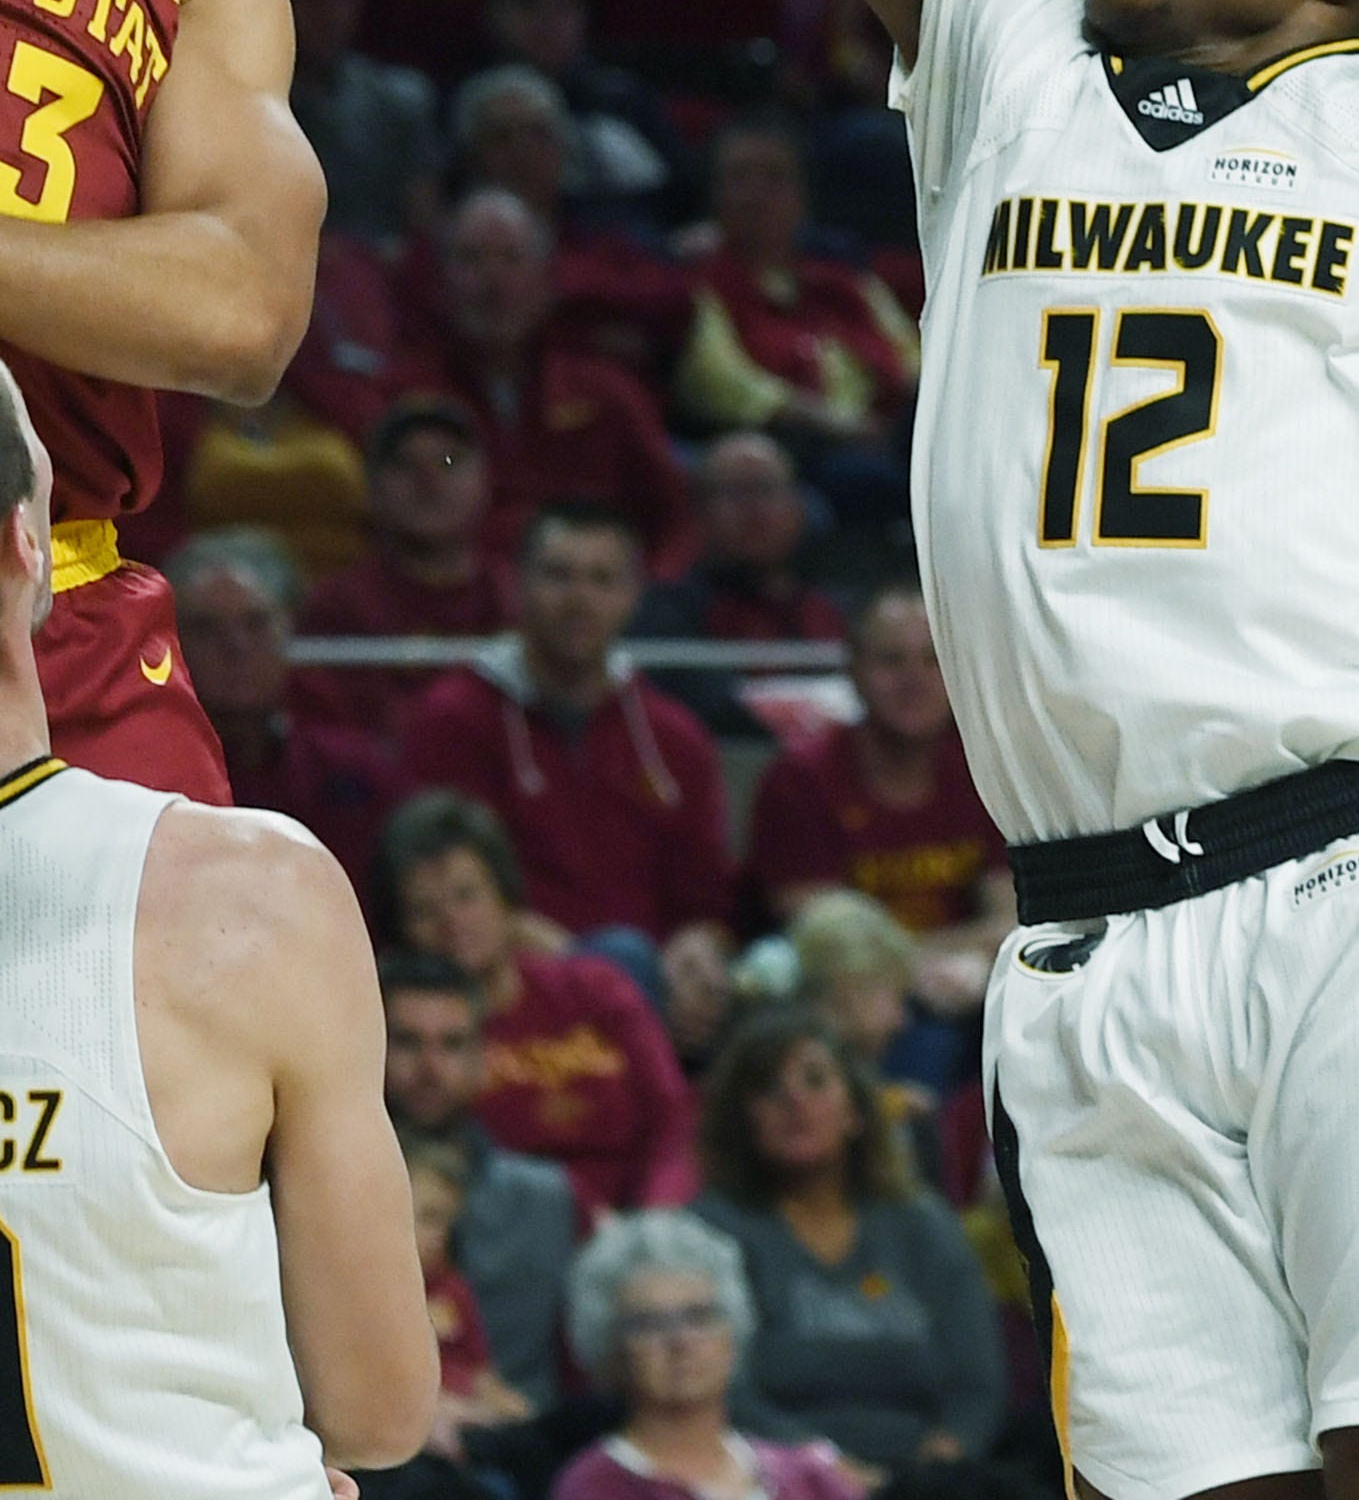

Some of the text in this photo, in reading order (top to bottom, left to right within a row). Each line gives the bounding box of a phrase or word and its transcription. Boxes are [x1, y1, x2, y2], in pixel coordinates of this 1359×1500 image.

[1137, 99, 1205, 126] adidas
[1213, 156, 1298, 178] HORIZON
[981, 197, 1356, 298] MILWAUKEE
[1037, 306, 1225, 550] 12
